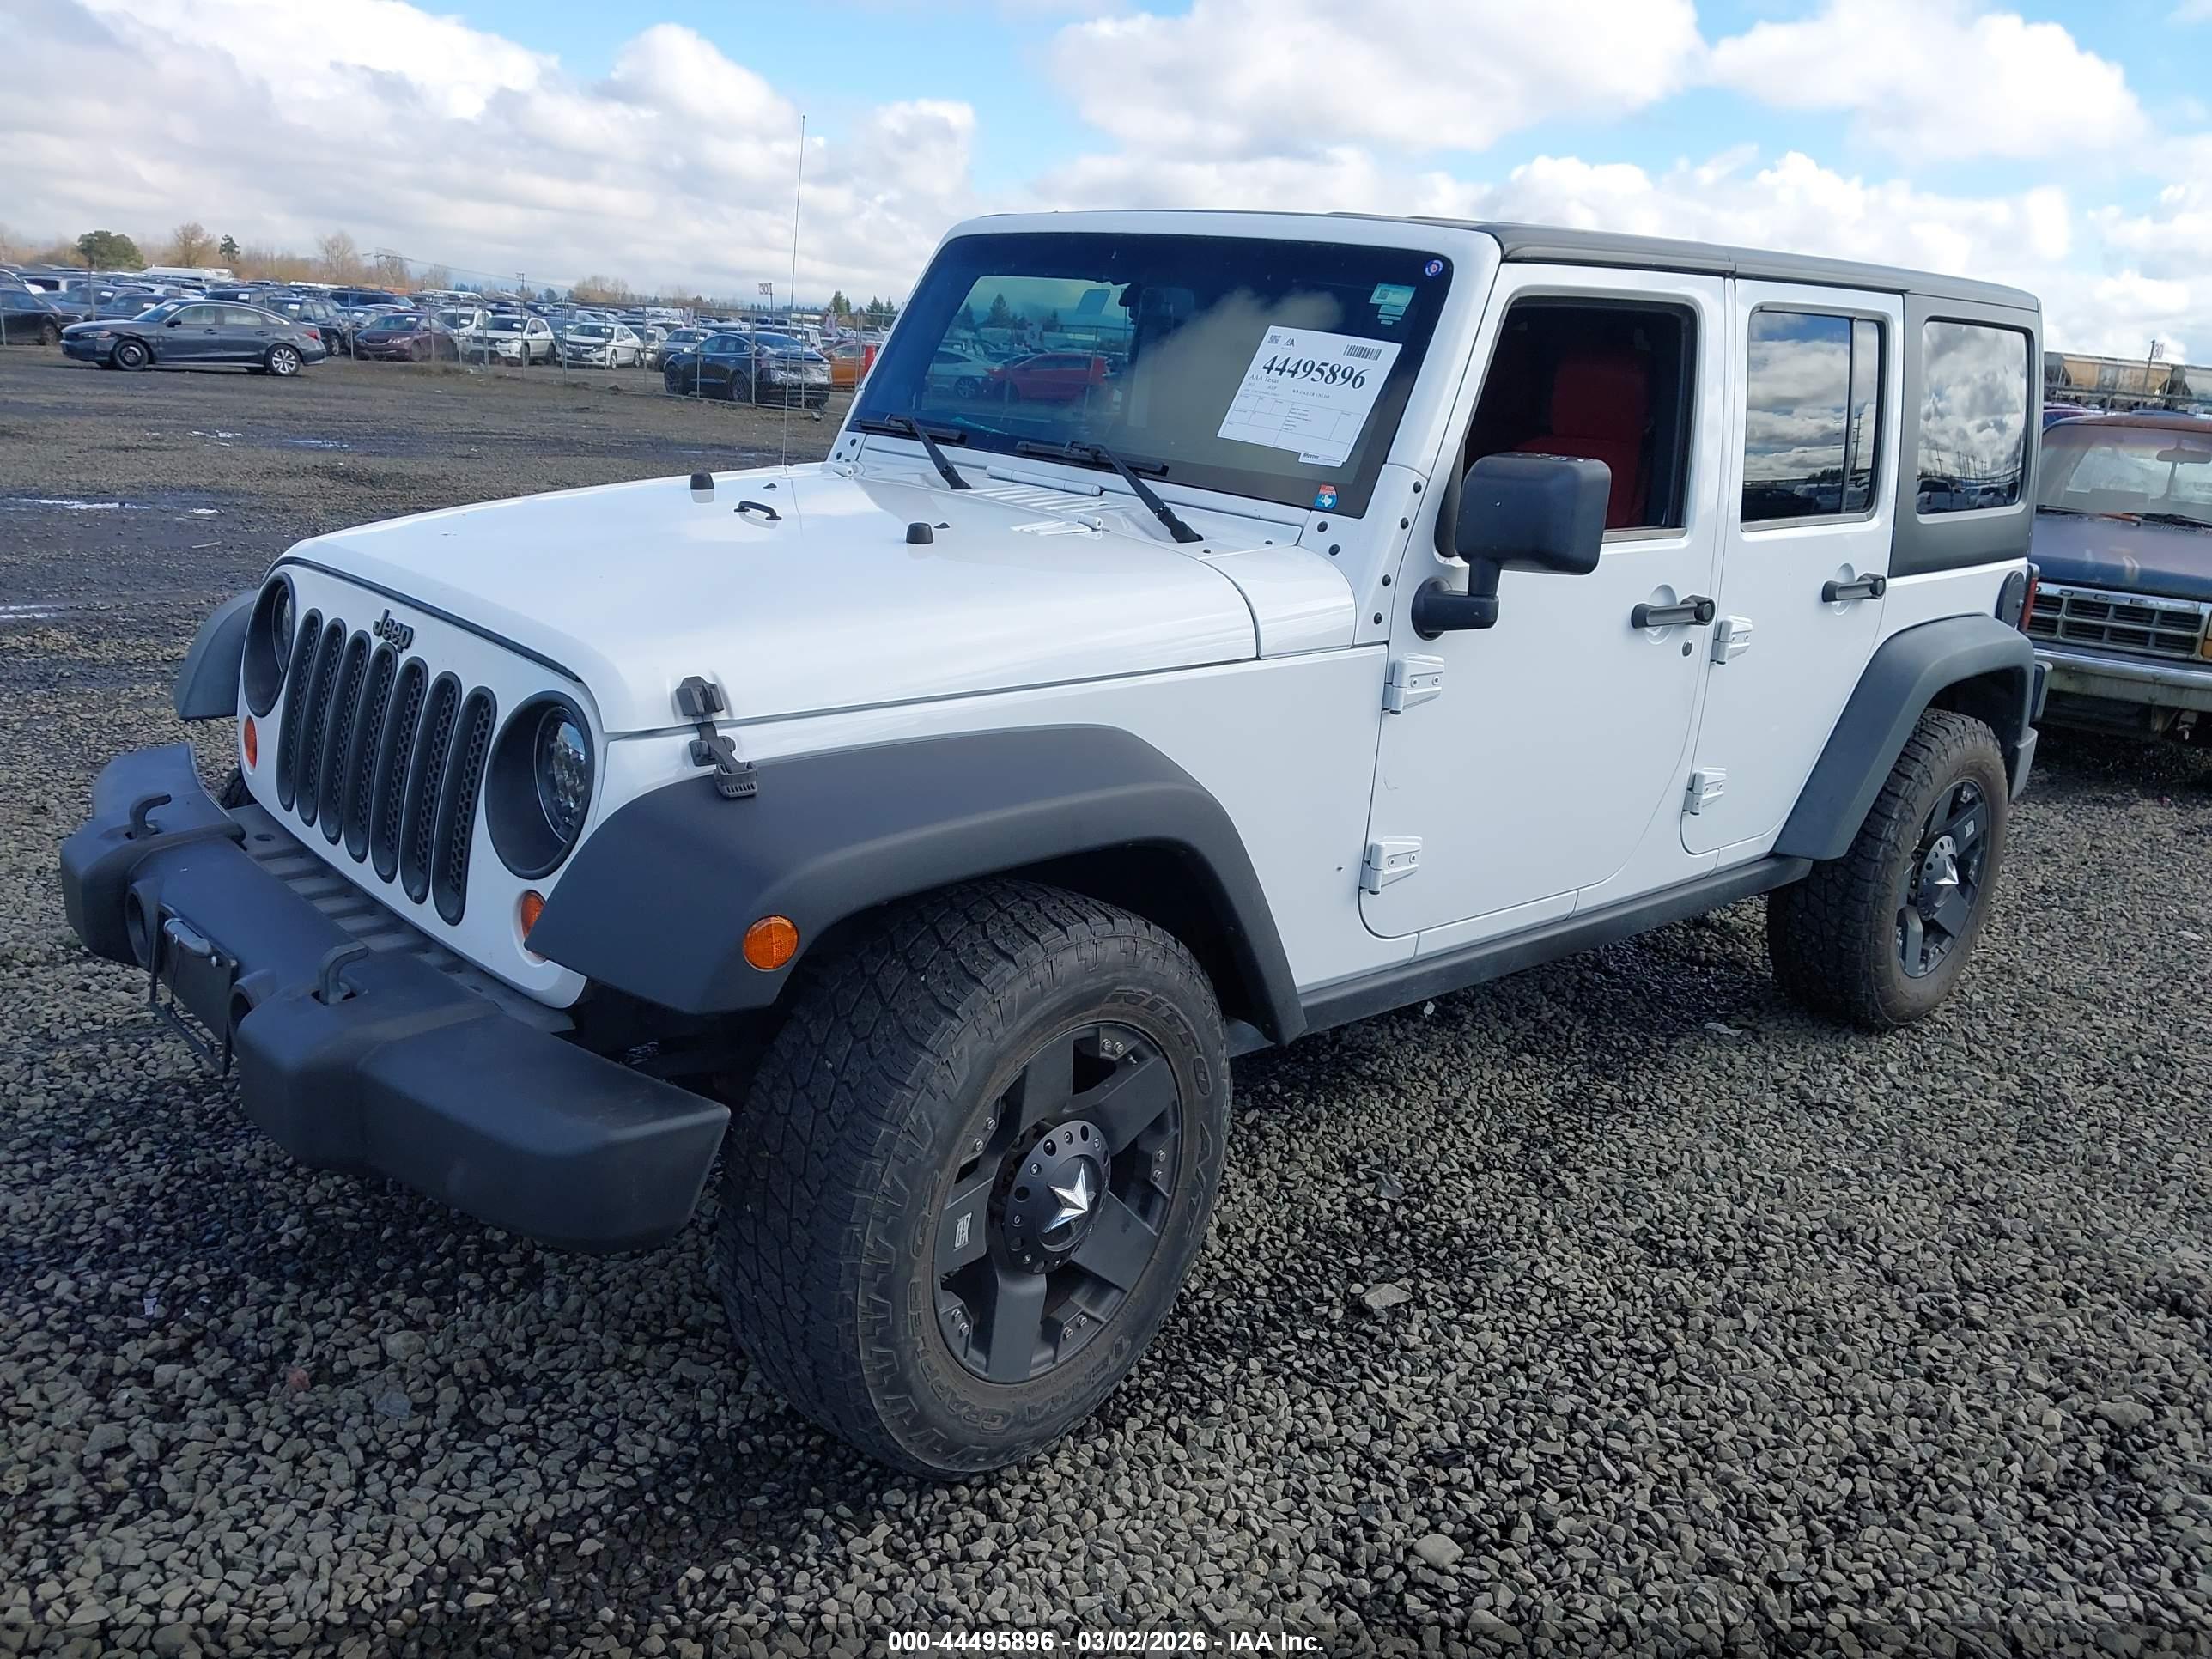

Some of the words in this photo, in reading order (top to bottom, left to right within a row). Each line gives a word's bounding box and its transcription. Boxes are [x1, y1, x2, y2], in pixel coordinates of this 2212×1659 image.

[2152, 343, 2164, 358] 30
[1262, 354, 1373, 390] 44495896
[373, 608, 414, 653] Jeep
